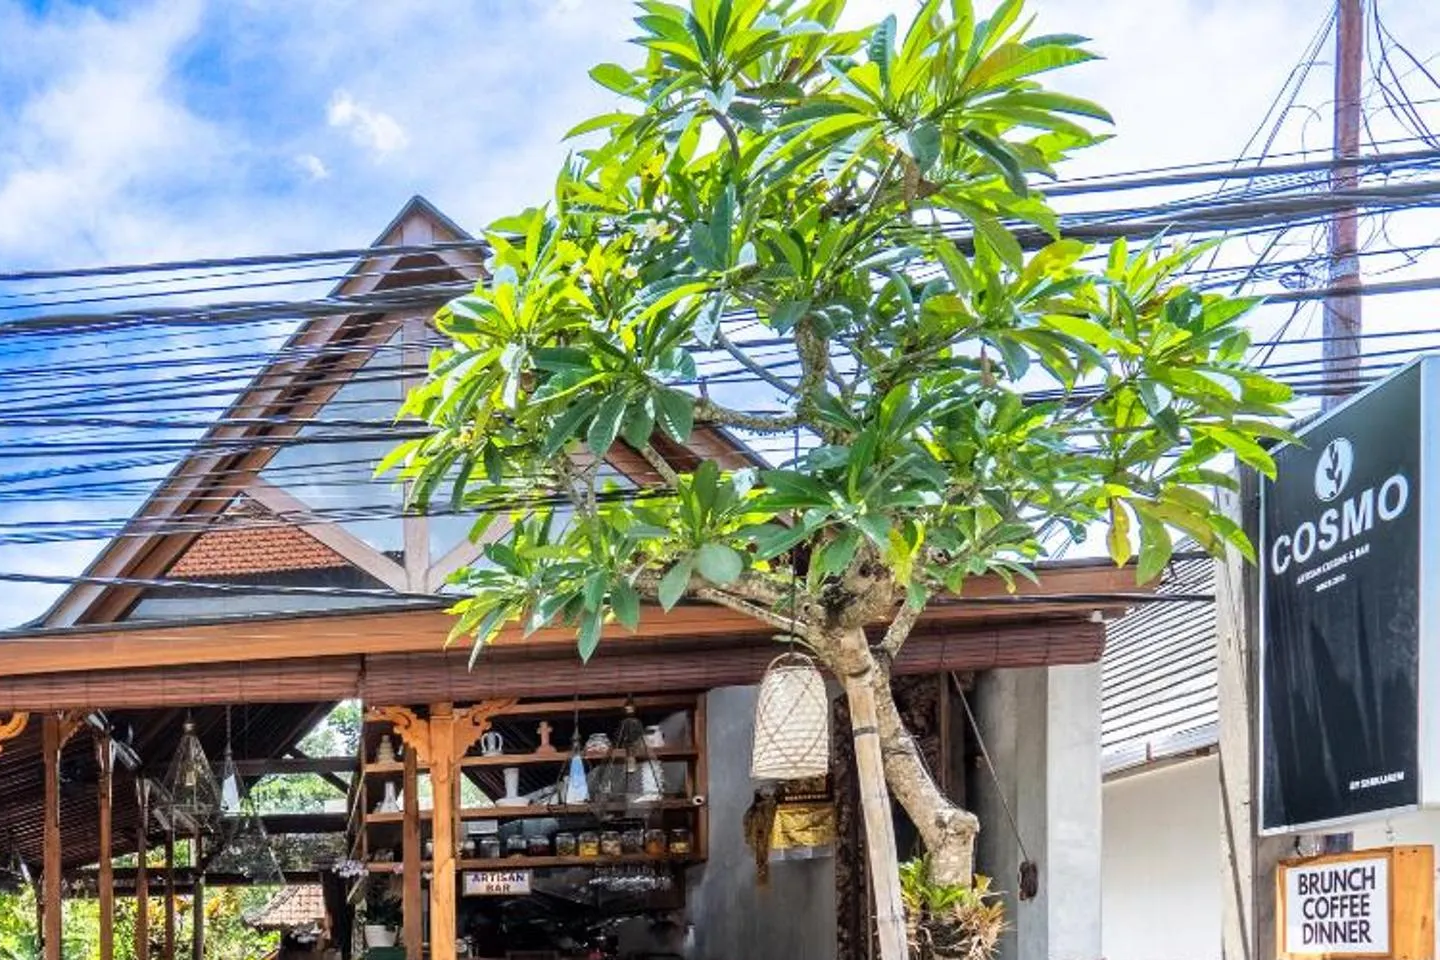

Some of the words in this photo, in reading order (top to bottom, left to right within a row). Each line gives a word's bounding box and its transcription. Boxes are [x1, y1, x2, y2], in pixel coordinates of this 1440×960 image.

[1271, 473, 1408, 575] COSMO
[471, 872, 525, 882] ARTISAN
[486, 884, 511, 892] BAR
[1297, 866, 1375, 896] BRUNCH
[1302, 893, 1370, 919] COFFEE
[1302, 919, 1372, 945] DINNER
